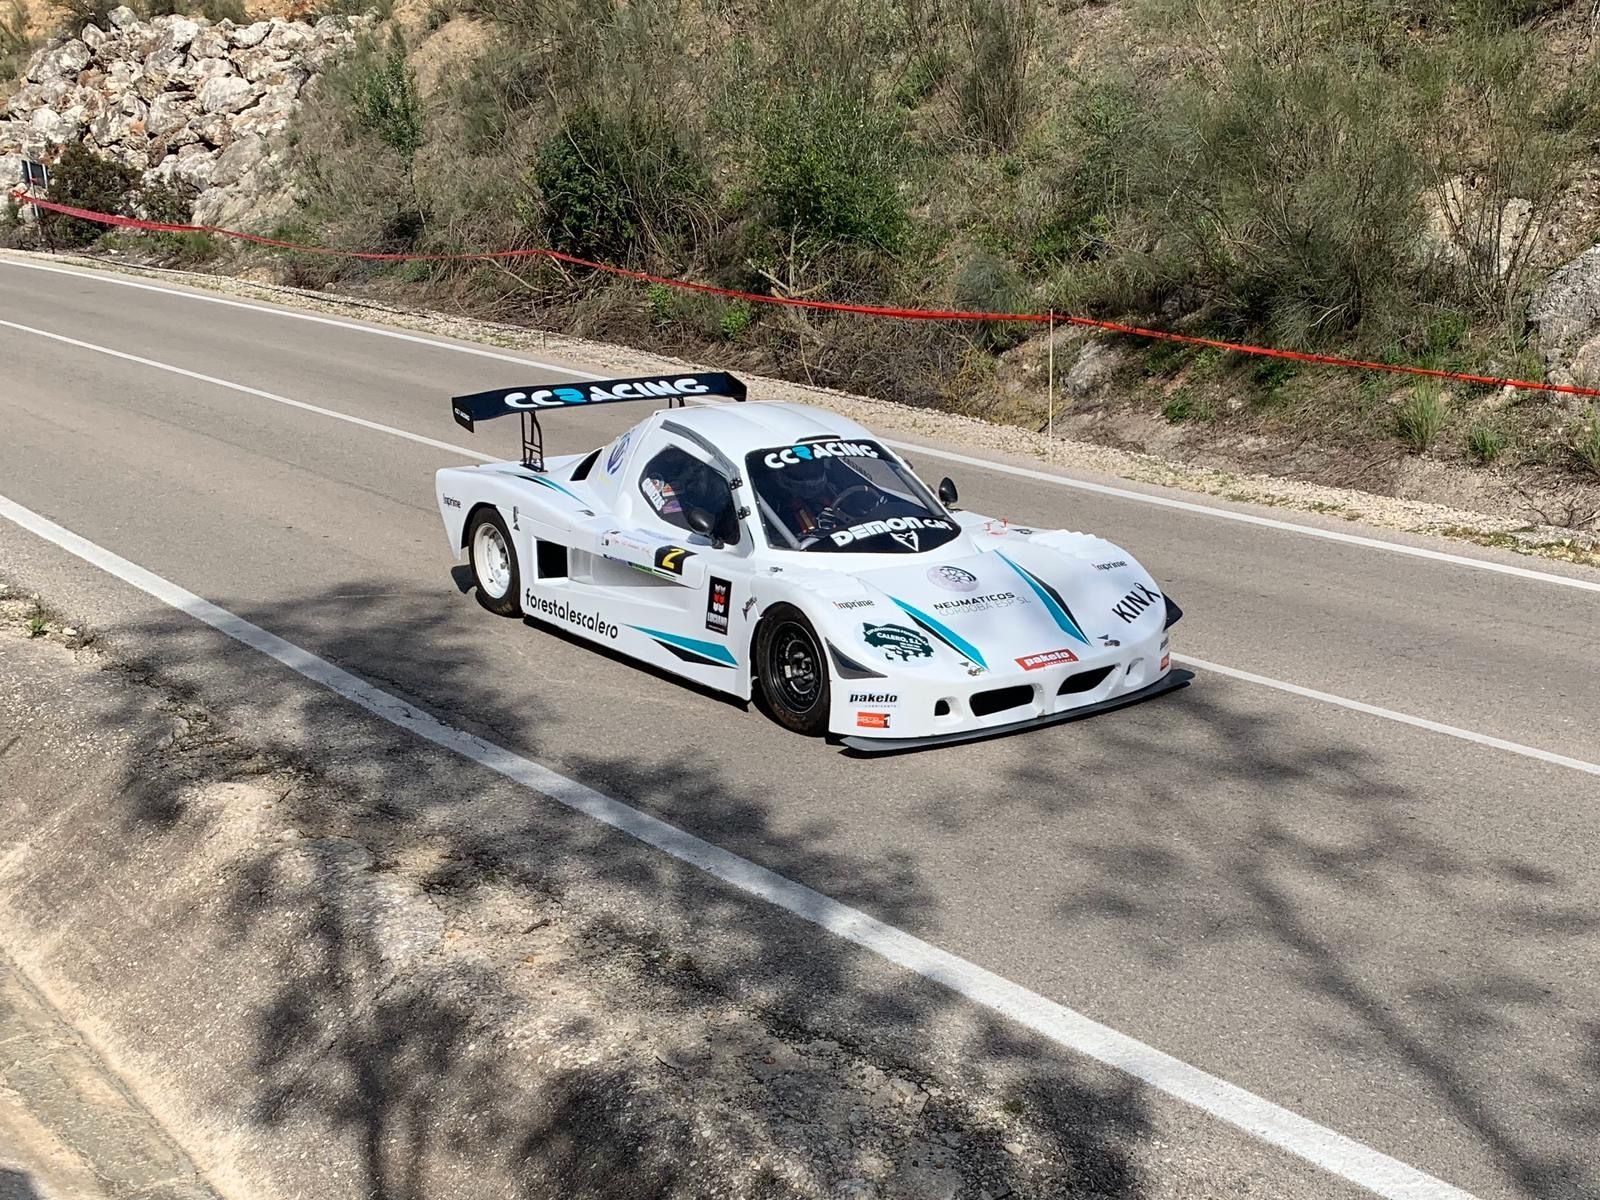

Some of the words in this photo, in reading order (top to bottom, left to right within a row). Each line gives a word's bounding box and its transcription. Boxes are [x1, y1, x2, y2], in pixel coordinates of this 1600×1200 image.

[830, 517, 925, 547] DEMON
[662, 548, 686, 569] 2
[932, 592, 1016, 610] NEUMATICOS
[525, 588, 619, 640] forestalescalero
[1023, 651, 1070, 667] pakelo
[849, 693, 898, 703] pakelo
